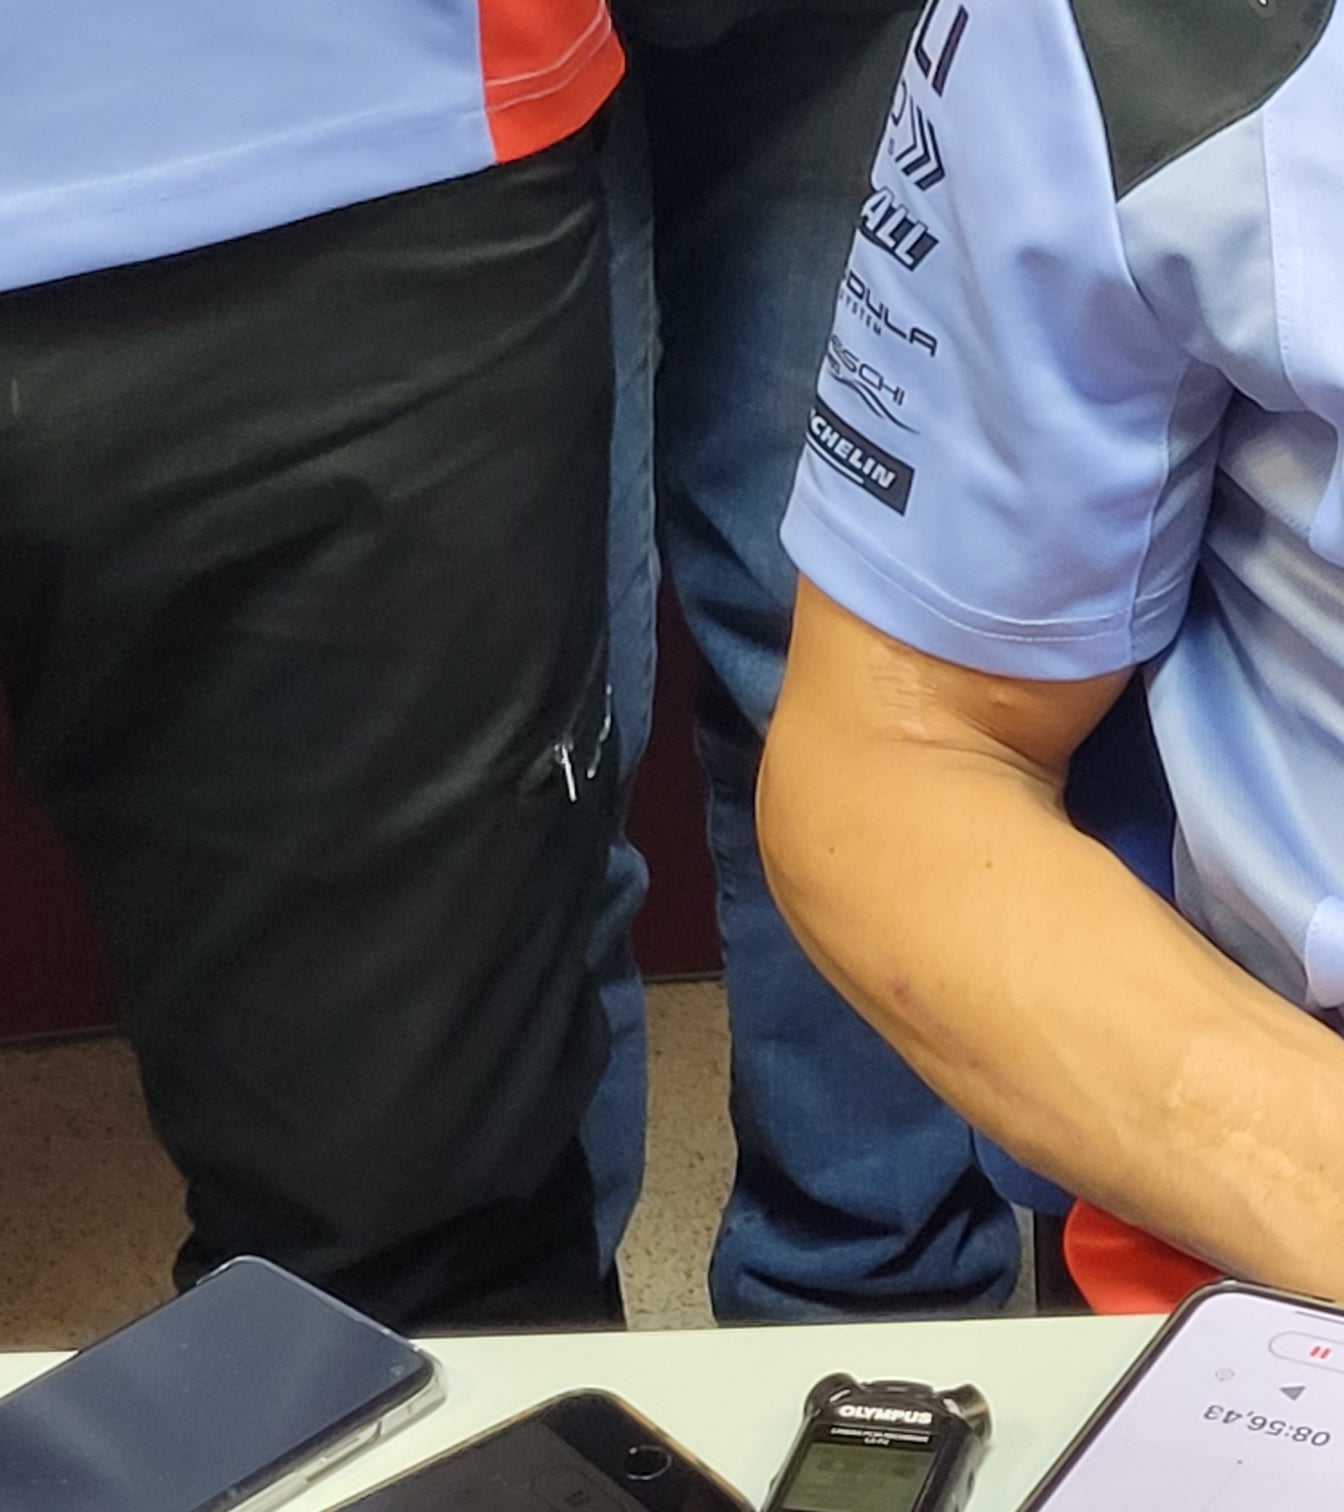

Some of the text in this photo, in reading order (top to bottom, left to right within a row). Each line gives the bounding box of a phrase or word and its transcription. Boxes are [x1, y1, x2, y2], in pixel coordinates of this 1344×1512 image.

[809, 408, 897, 489] CHELIN
[838, 1404, 933, 1425] OLYMPUS
[1203, 1404, 1332, 1447] 08:56,43
